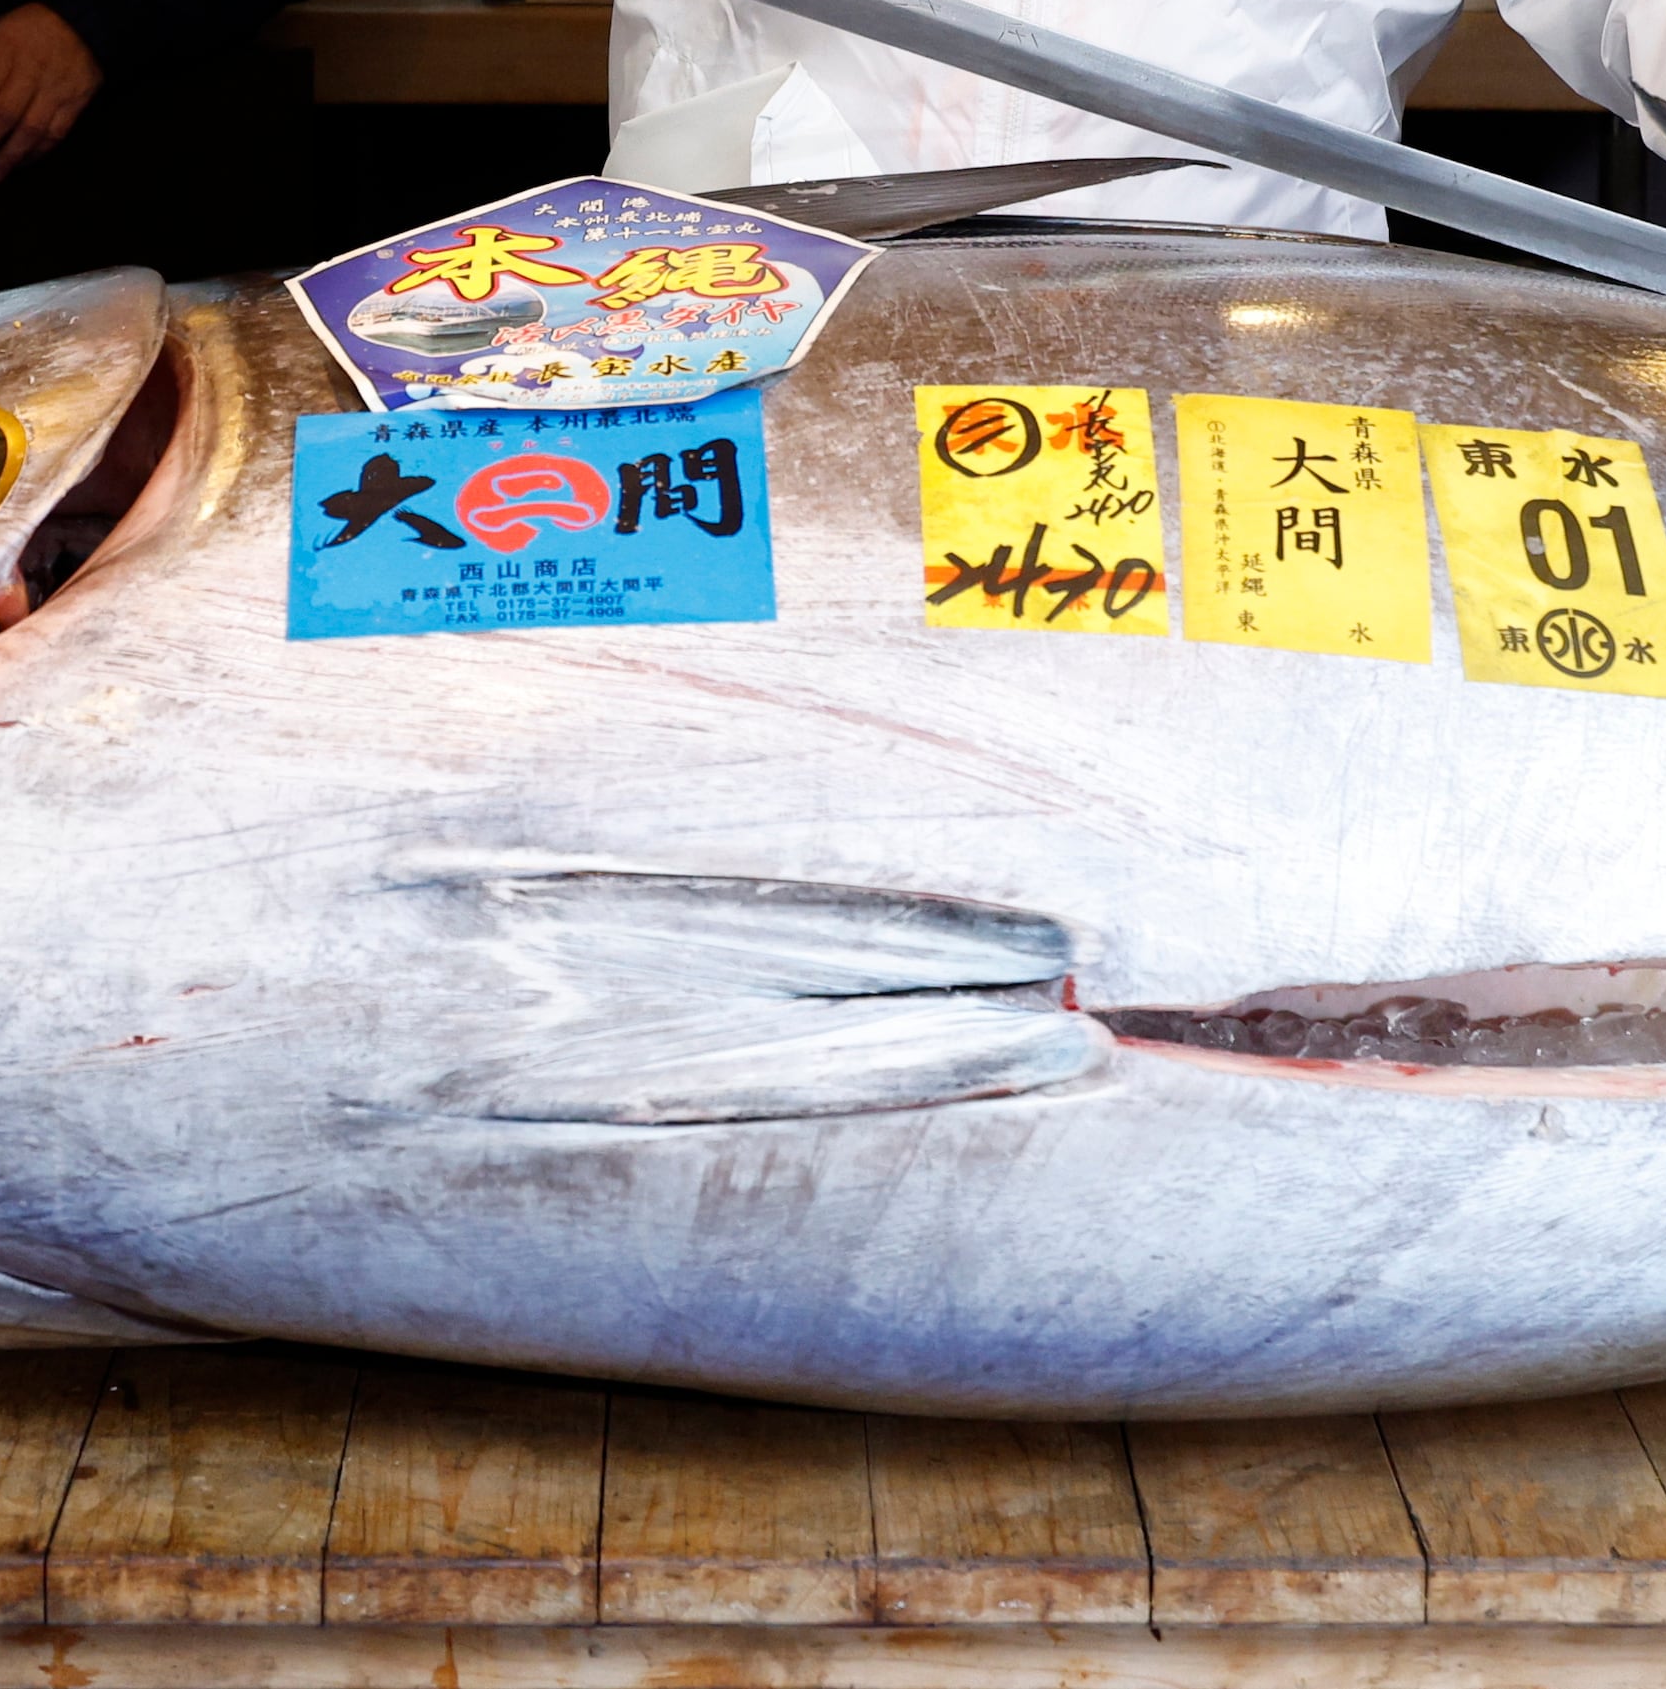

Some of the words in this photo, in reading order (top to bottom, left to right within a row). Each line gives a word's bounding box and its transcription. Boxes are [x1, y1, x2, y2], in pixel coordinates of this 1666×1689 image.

[388, 225, 785, 309] 本縄
[530, 351, 749, 382] 長宝水産
[369, 418, 504, 444] 青森県産
[523, 406, 697, 434] 本州最北端
[1344, 415, 1384, 492] 青森県
[1269, 435, 1351, 570] 大間
[1519, 498, 1647, 597] 01
[458, 558, 598, 582] 西山商店
[445, 601, 478, 613] TEL
[445, 612, 480, 626] FAX
